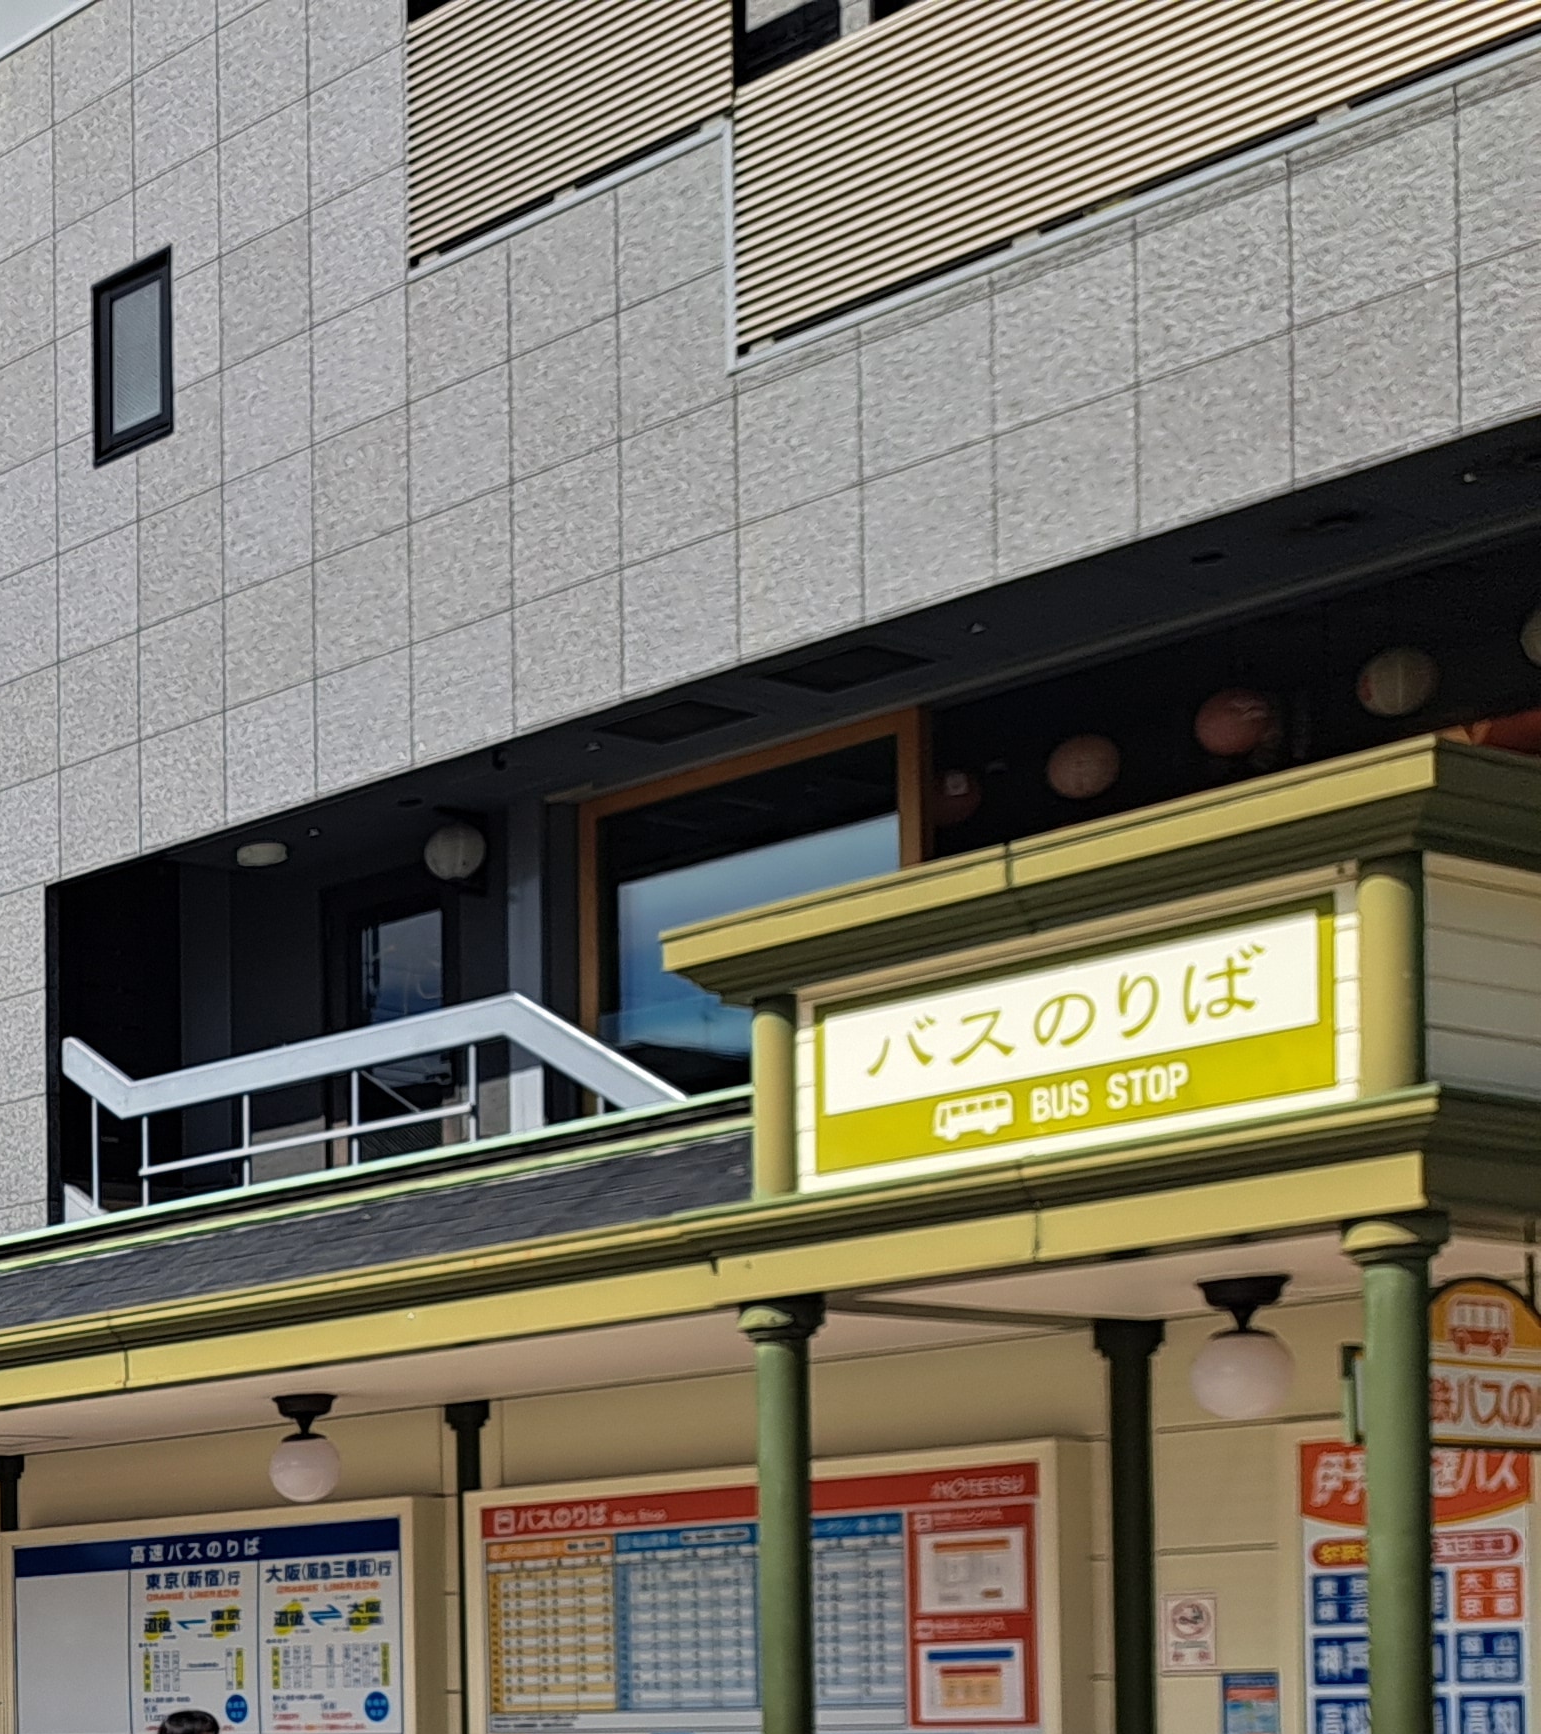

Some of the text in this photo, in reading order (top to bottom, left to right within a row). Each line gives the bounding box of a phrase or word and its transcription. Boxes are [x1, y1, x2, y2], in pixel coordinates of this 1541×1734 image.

[866, 943, 1268, 1077] バスのりば
[1028, 1062, 1190, 1125] BUS STOP
[1430, 1375, 1541, 1428] バスの
[518, 1502, 609, 1531] バスのりば
[130, 1536, 262, 1564] 高速バスのりば
